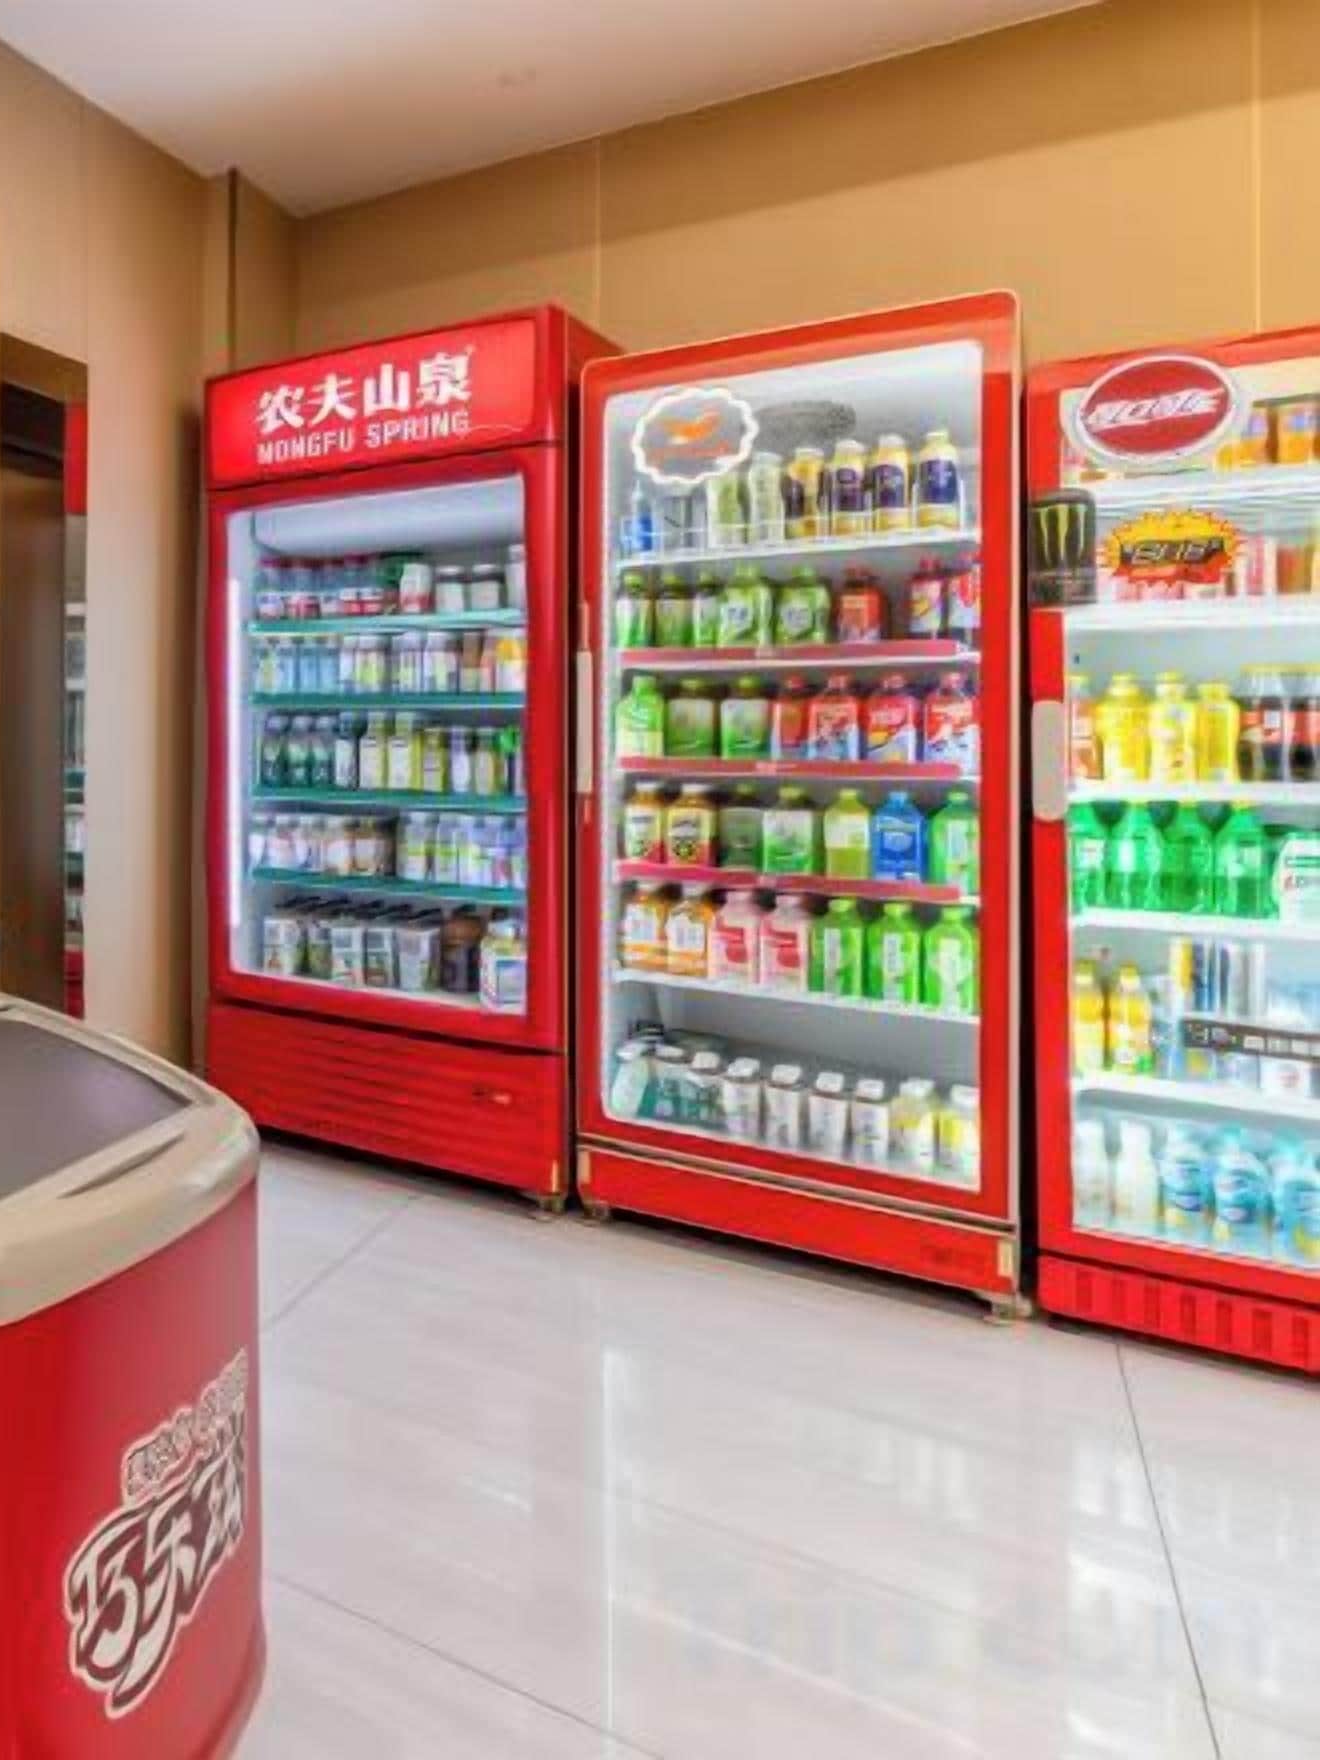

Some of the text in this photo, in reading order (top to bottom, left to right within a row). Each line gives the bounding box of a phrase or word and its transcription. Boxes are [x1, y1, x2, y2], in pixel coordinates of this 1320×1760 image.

[256, 352, 472, 433] 农夫山泉
[365, 411, 470, 449] SPRING
